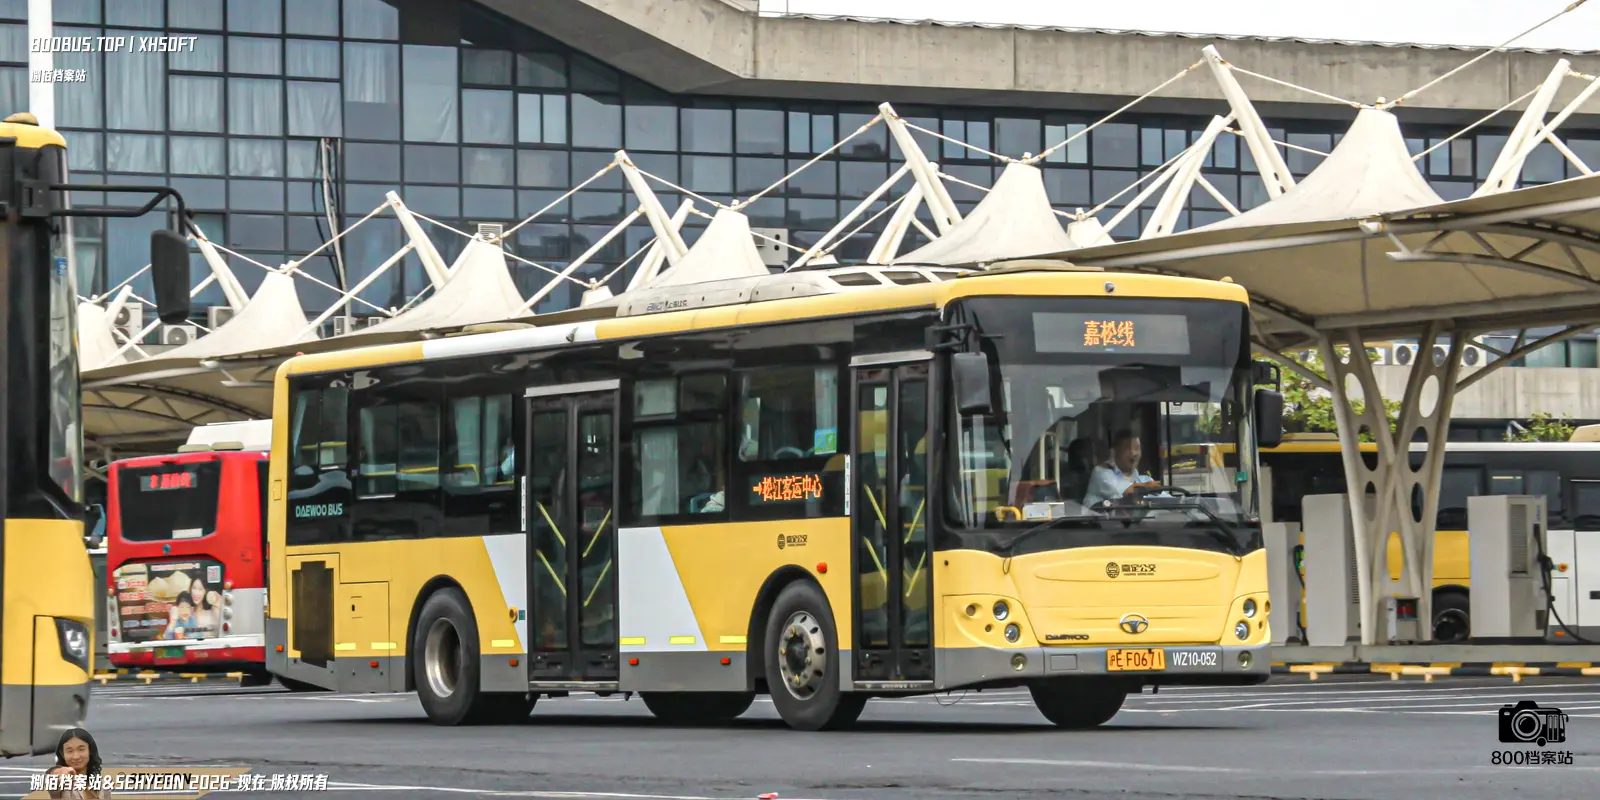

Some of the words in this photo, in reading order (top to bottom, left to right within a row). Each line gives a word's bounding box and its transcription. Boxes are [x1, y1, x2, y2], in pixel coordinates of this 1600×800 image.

[1084, 320, 1135, 346] 嘉松线
[762, 474, 823, 501] 松江客运中心
[295, 504, 327, 518] DAEWOO
[327, 503, 343, 516] BUS
[1172, 651, 1217, 666] WZ10-052
